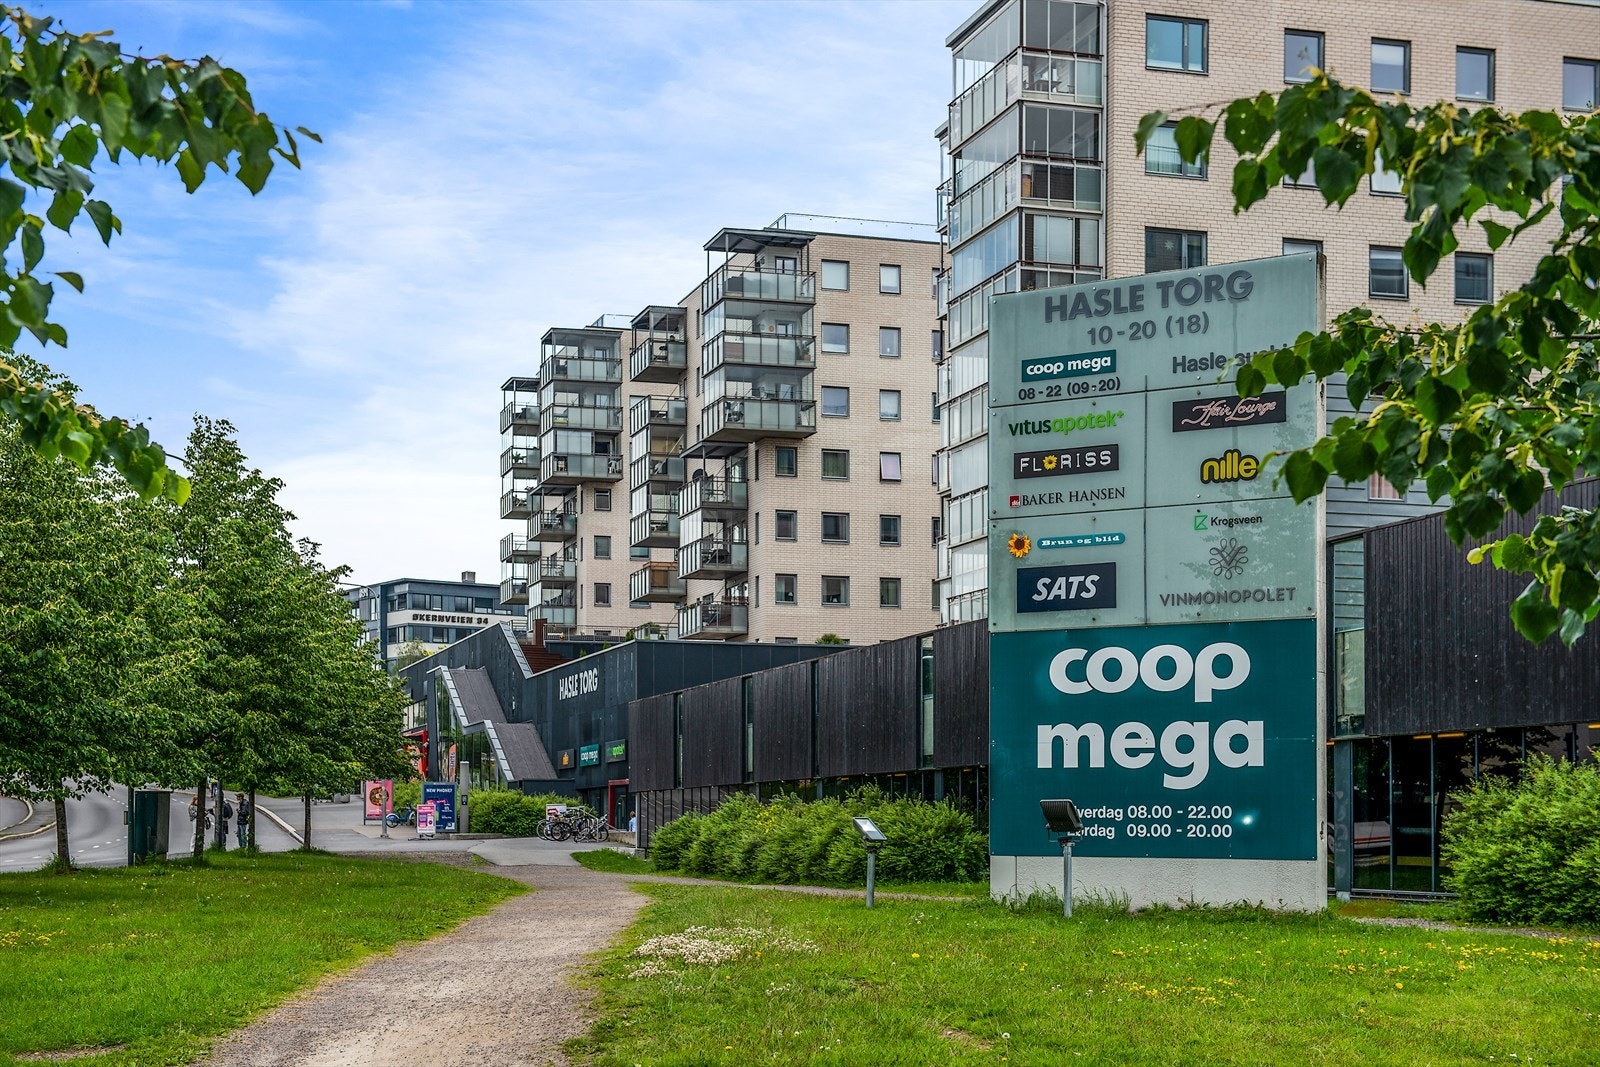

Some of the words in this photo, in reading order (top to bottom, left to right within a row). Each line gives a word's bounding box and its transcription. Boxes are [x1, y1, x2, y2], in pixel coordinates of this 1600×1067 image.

[1044, 285, 1145, 324] HASLE
[1156, 270, 1254, 309] TORG
[1165, 311, 1210, 338] (18)
[1026, 362, 1064, 375] coop
[1067, 357, 1111, 371] mega
[1172, 352, 1227, 374] Hasle
[1181, 399, 1231, 427] Hair
[1225, 396, 1277, 422] Lounge
[1202, 451, 1258, 482] nille
[1022, 492, 1064, 507] BAKER
[1069, 487, 1126, 503] HANSEN
[1210, 515, 1263, 529] Krogsveen
[1095, 535, 1120, 543] blid
[1031, 574, 1101, 602] SATS
[1159, 586, 1297, 607] VINMONOPOLET
[412, 613, 473, 624] ØKERNVEIEN
[1049, 642, 1251, 703] coop
[559, 673, 579, 701] HASLE
[579, 667, 598, 695] TORG
[1037, 719, 1265, 790] mega
[1074, 805, 1124, 821] verdag
[1127, 805, 1172, 819] 08.00
[1187, 805, 1232, 819] 22.00
[1126, 824, 1171, 838] 09.00
[1186, 824, 1232, 838] 20.00
